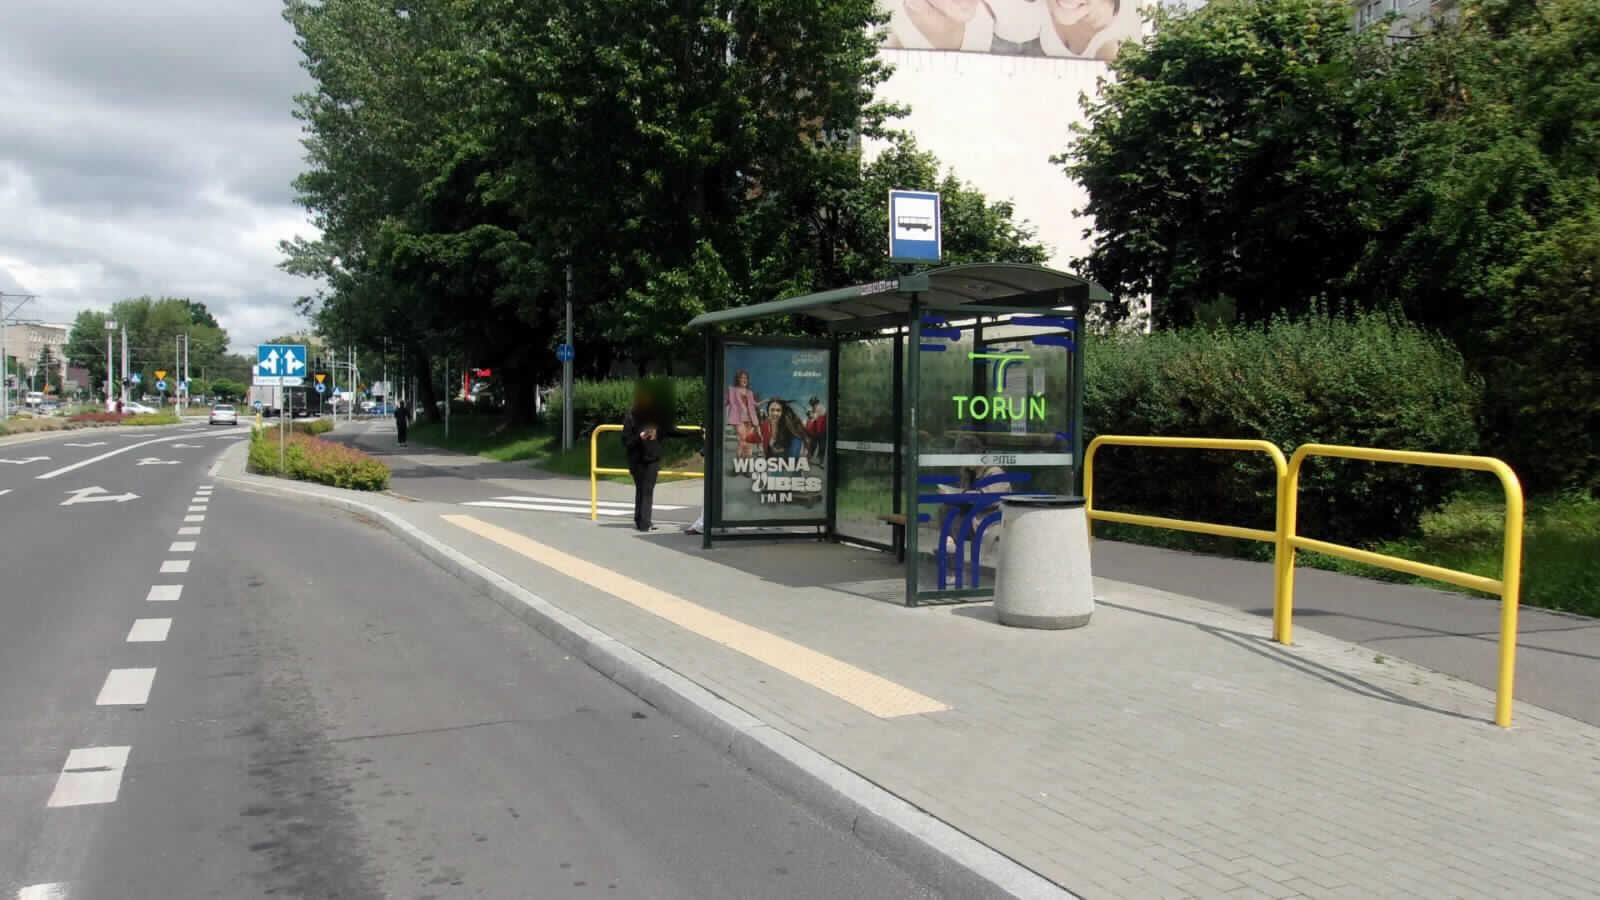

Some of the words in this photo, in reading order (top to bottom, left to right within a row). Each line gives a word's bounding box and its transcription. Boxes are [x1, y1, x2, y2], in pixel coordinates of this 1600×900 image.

[952, 392, 1046, 420] TORUŃ
[733, 456, 810, 473] WIOSNA
[751, 472, 822, 492] VIBES
[779, 492, 793, 503] IN
